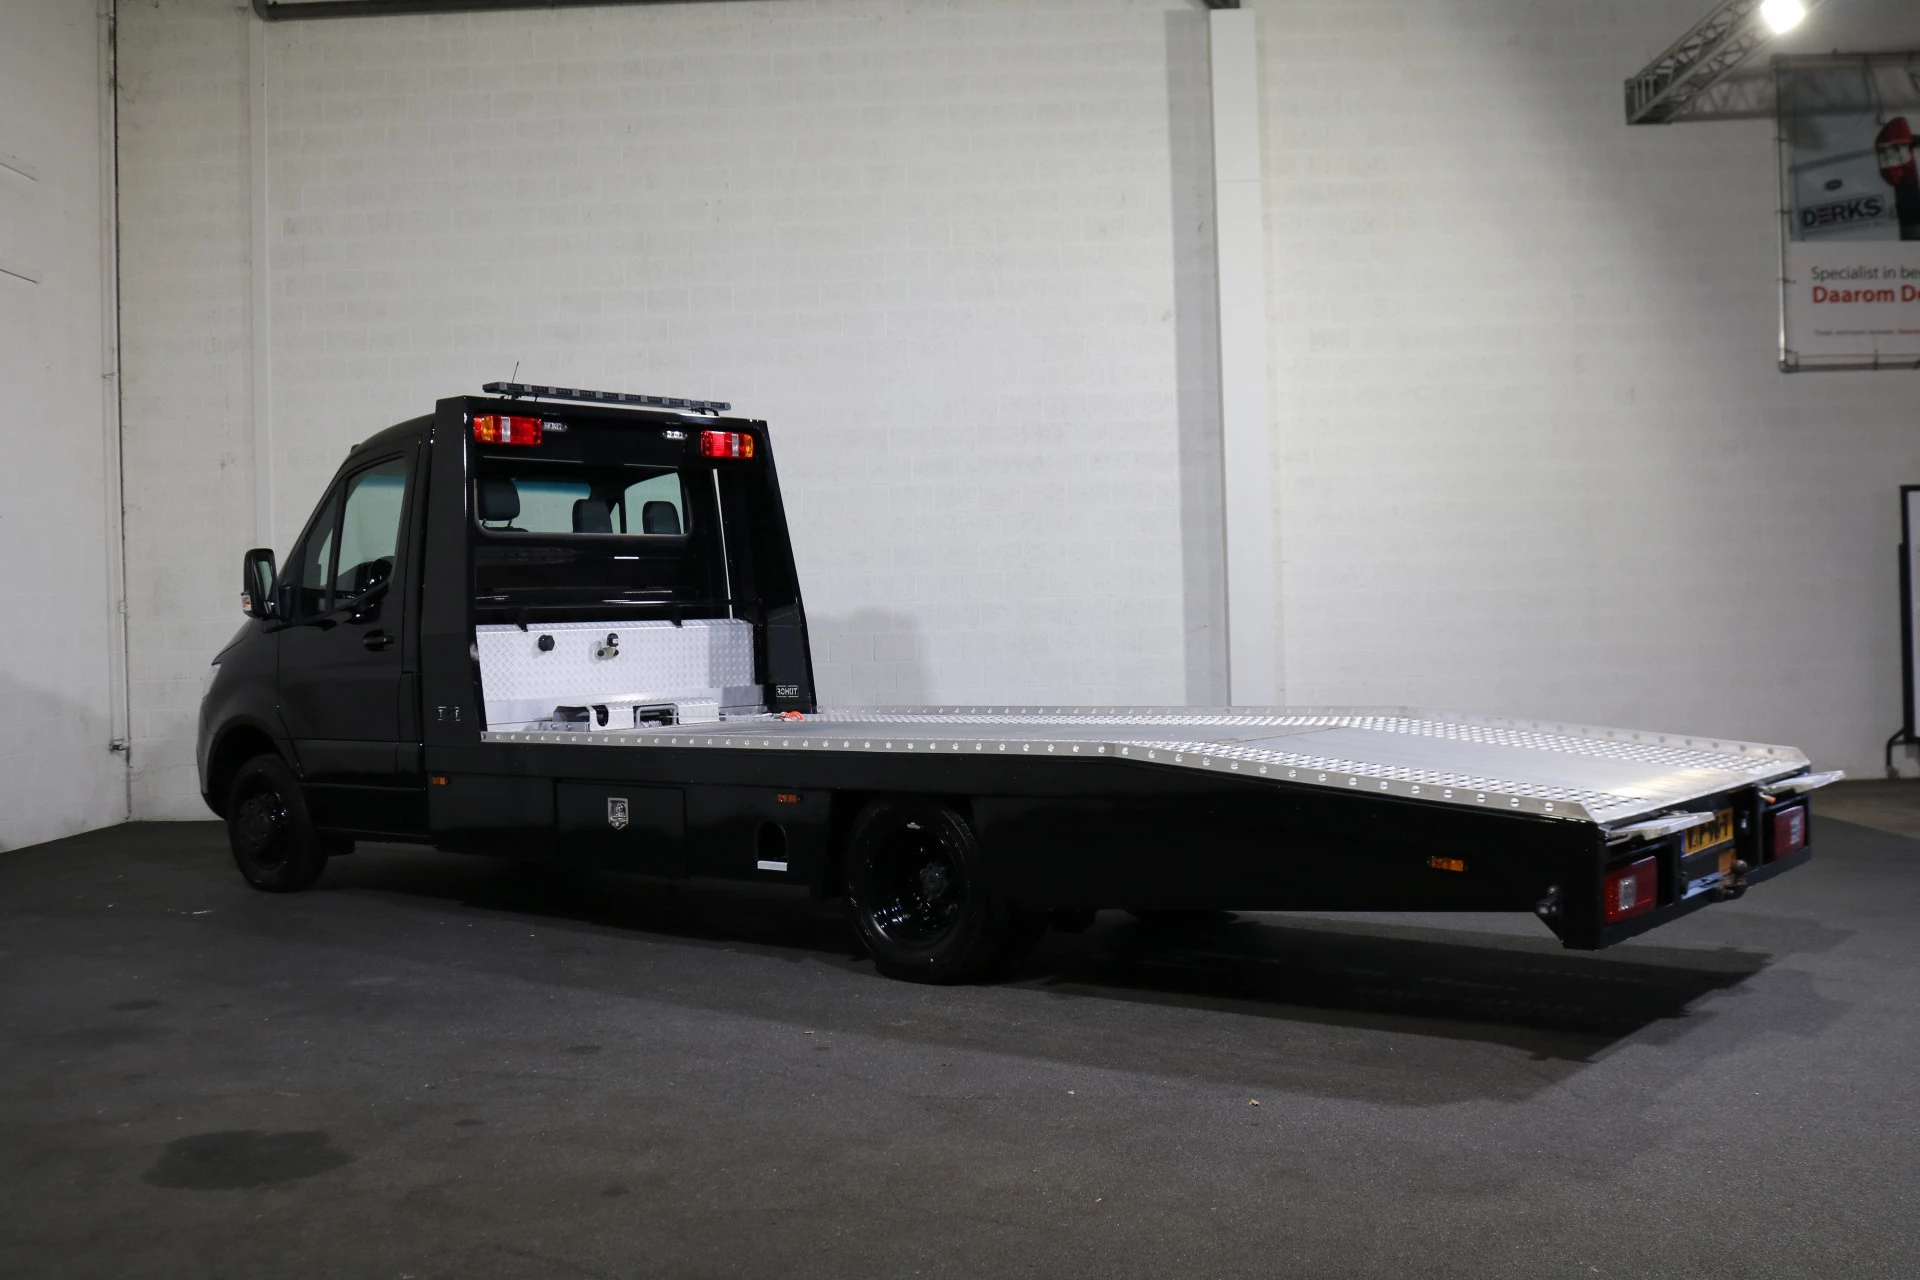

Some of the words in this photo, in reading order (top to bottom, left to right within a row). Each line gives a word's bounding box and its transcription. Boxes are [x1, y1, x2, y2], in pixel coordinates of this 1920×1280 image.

[1803, 199, 1882, 226] DERKS
[1811, 265, 1878, 282] Specialist
[1883, 265, 1897, 279] in
[1813, 285, 1895, 303] Daarom
[1901, 284, 1920, 302] D
